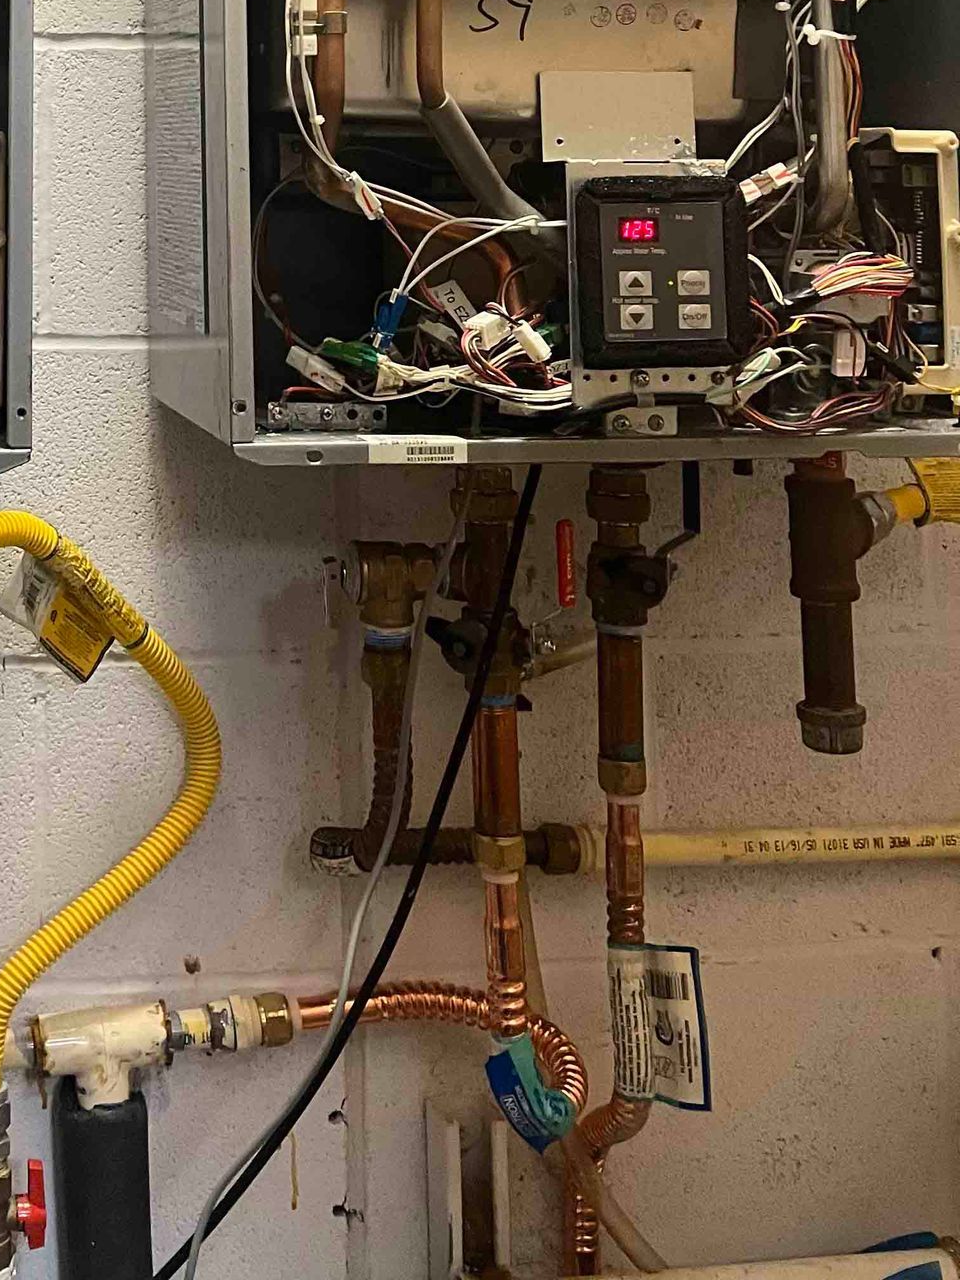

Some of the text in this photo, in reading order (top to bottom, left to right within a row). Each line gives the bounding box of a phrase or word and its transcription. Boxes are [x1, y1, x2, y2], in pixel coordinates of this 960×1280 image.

[623, 221, 654, 238] 125
[444, 288, 456, 304] To
[852, 838, 870, 849] USA
[874, 837, 884, 848] IN
[889, 836, 910, 848] MADE
